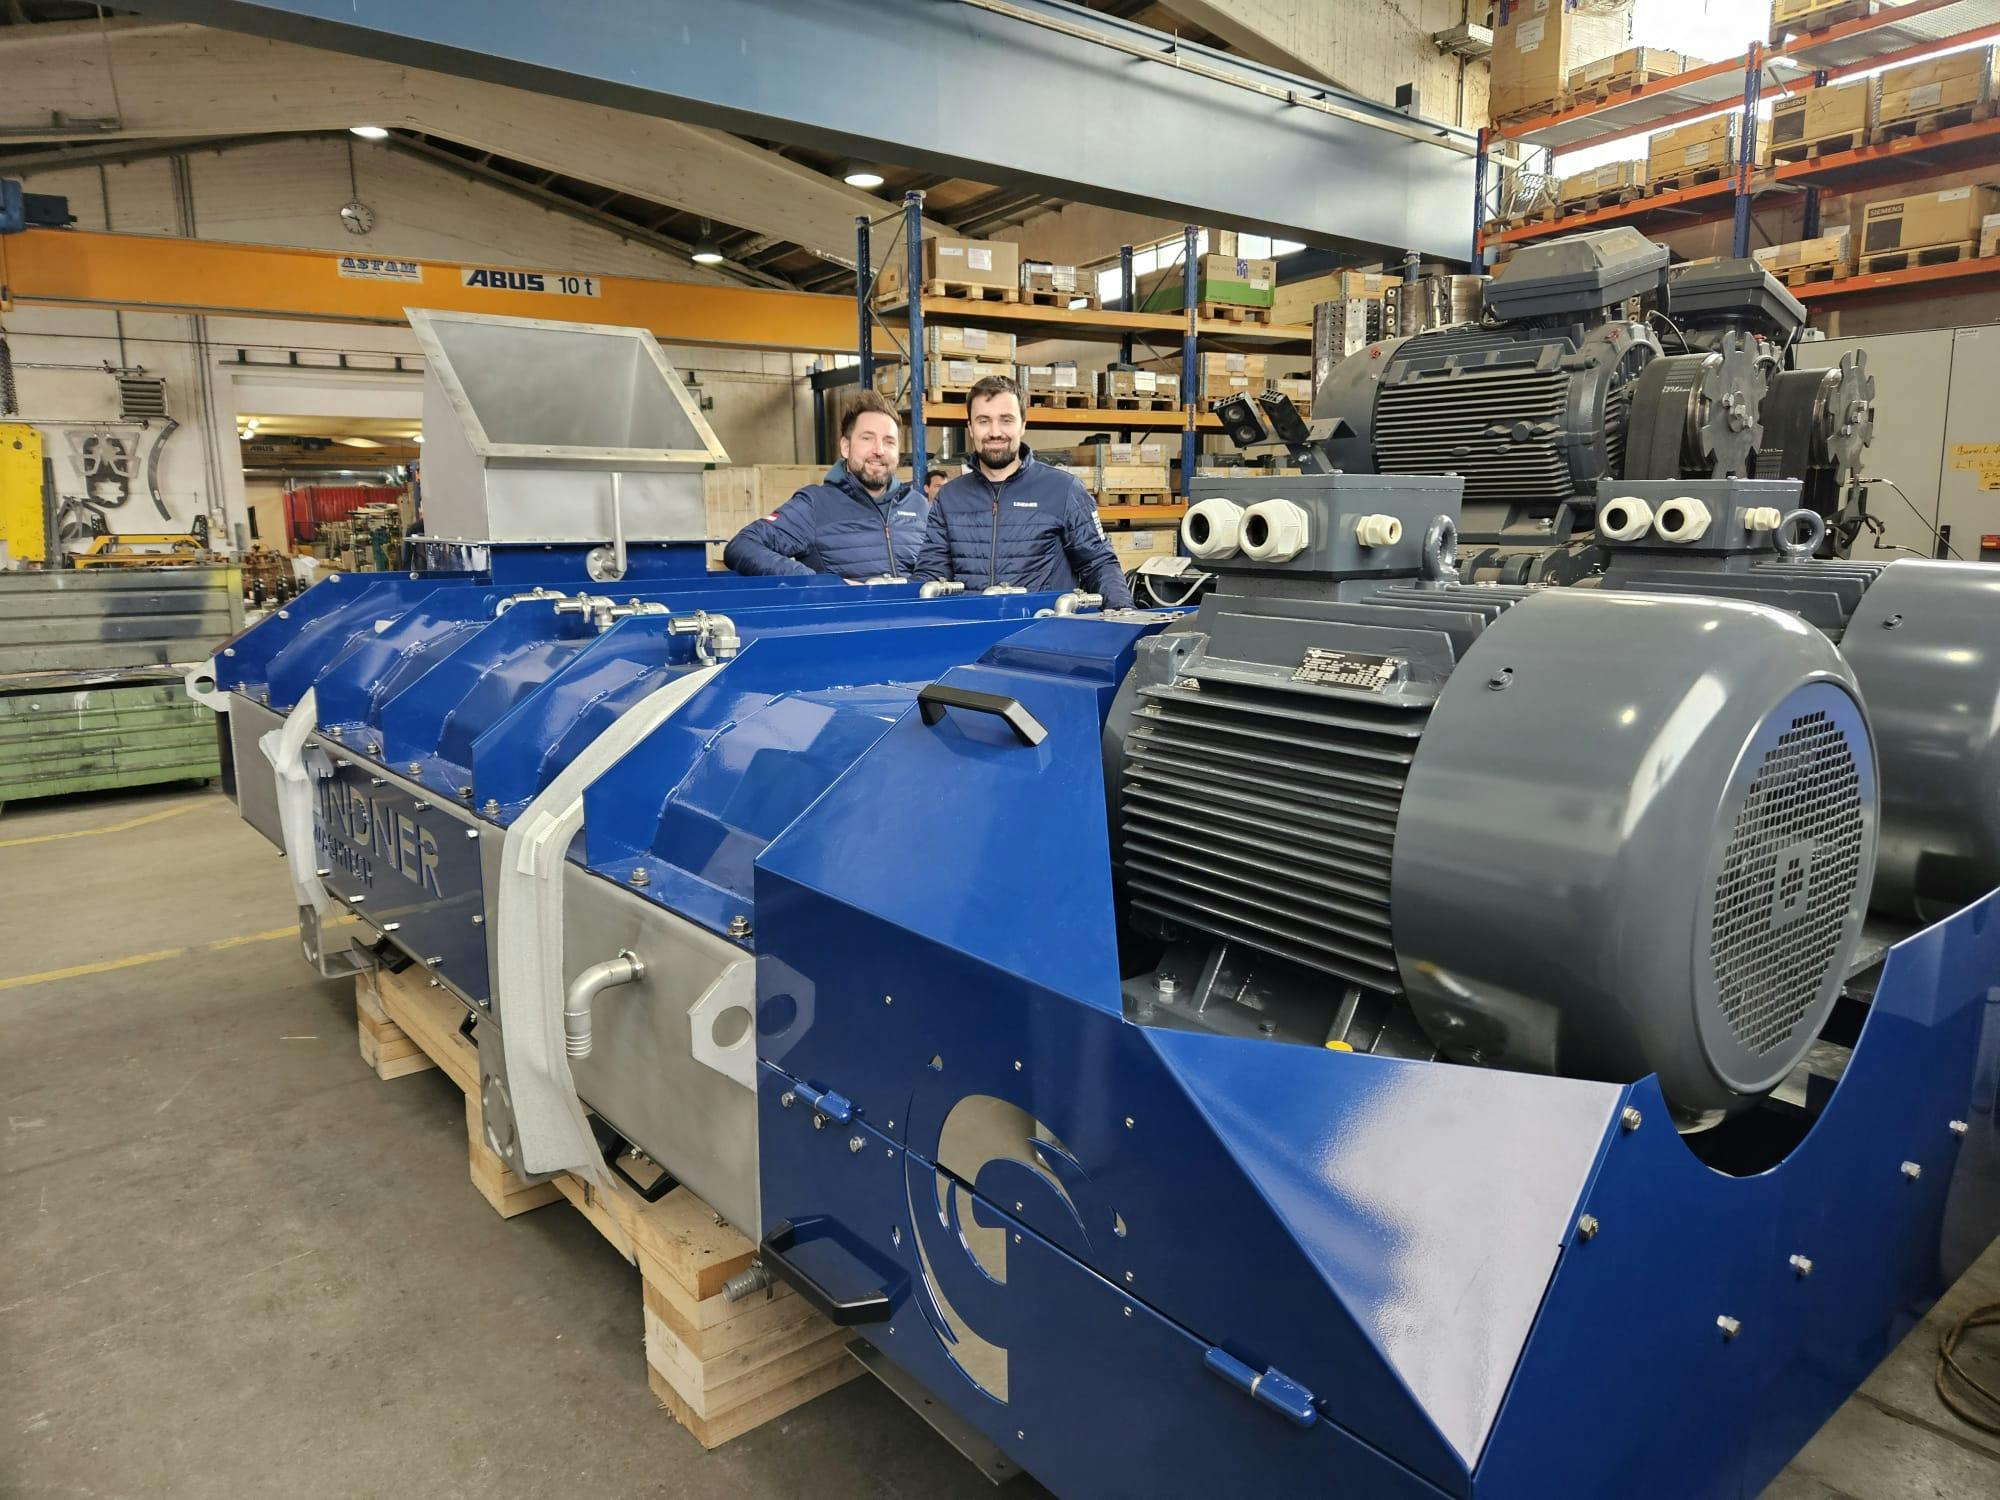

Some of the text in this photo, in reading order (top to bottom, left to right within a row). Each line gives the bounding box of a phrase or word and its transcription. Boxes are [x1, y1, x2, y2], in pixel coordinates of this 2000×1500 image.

[1869, 205, 1903, 217] SIEMENS
[466, 269, 593, 296] ABUS 10 t
[305, 760, 444, 899] INDNER
